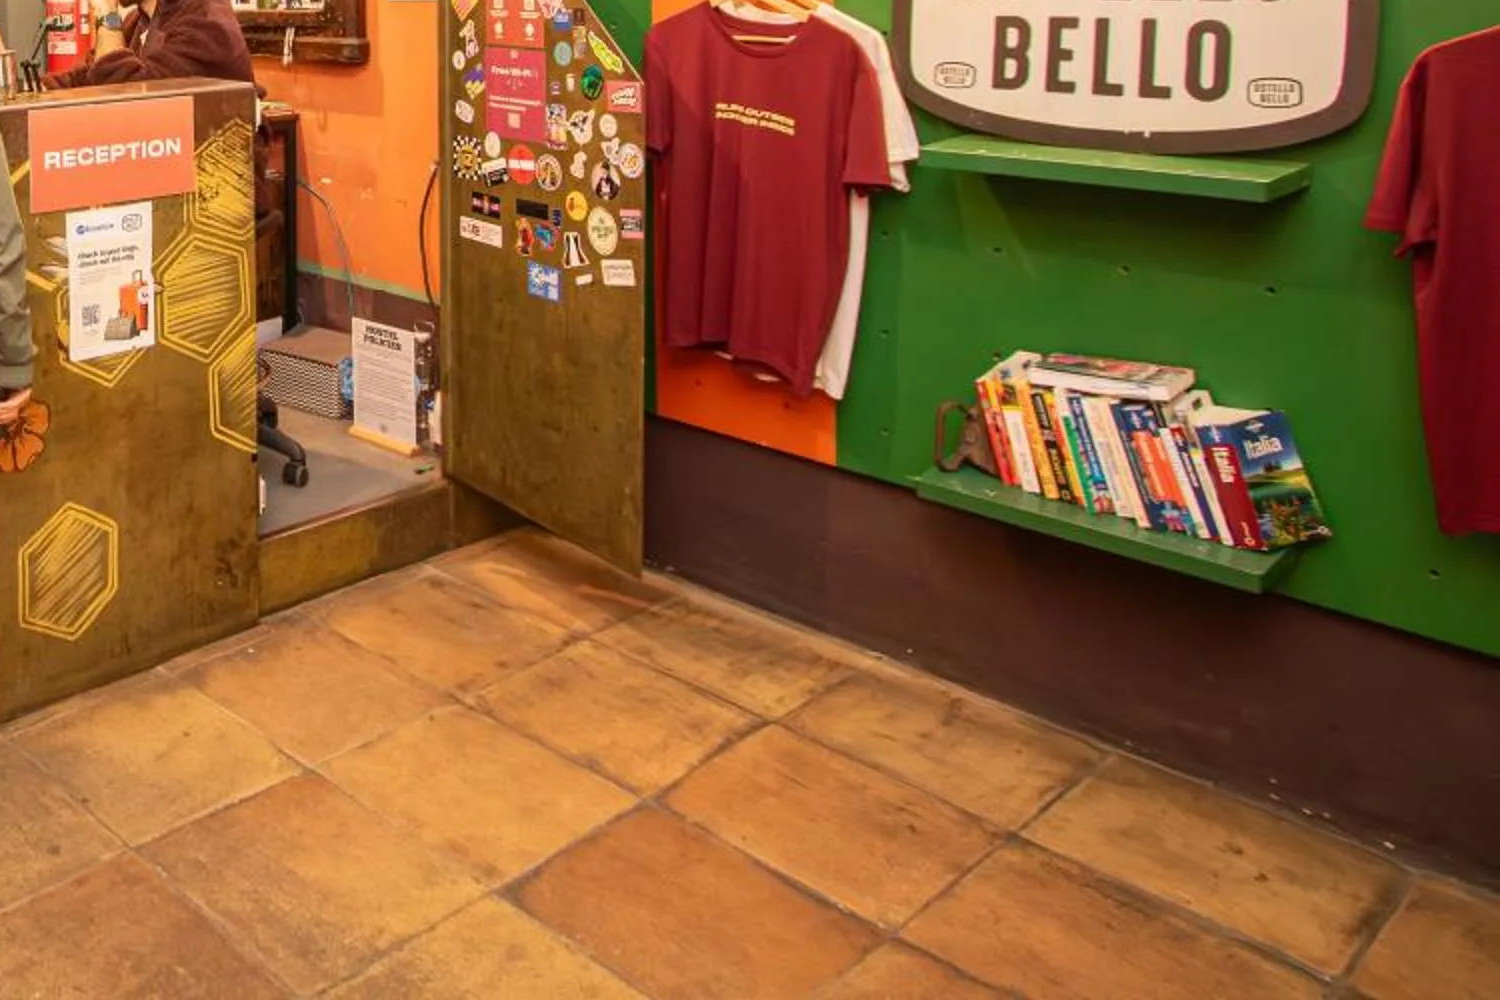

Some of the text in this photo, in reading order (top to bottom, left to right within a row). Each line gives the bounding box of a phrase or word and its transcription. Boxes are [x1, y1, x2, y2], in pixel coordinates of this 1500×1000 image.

[991, 15, 1232, 102] BELLO
[1254, 83, 1295, 93] OSTELLO
[1260, 93, 1289, 104] BELLO
[43, 137, 181, 171] RECEPTION
[1243, 434, 1284, 460] Italia
